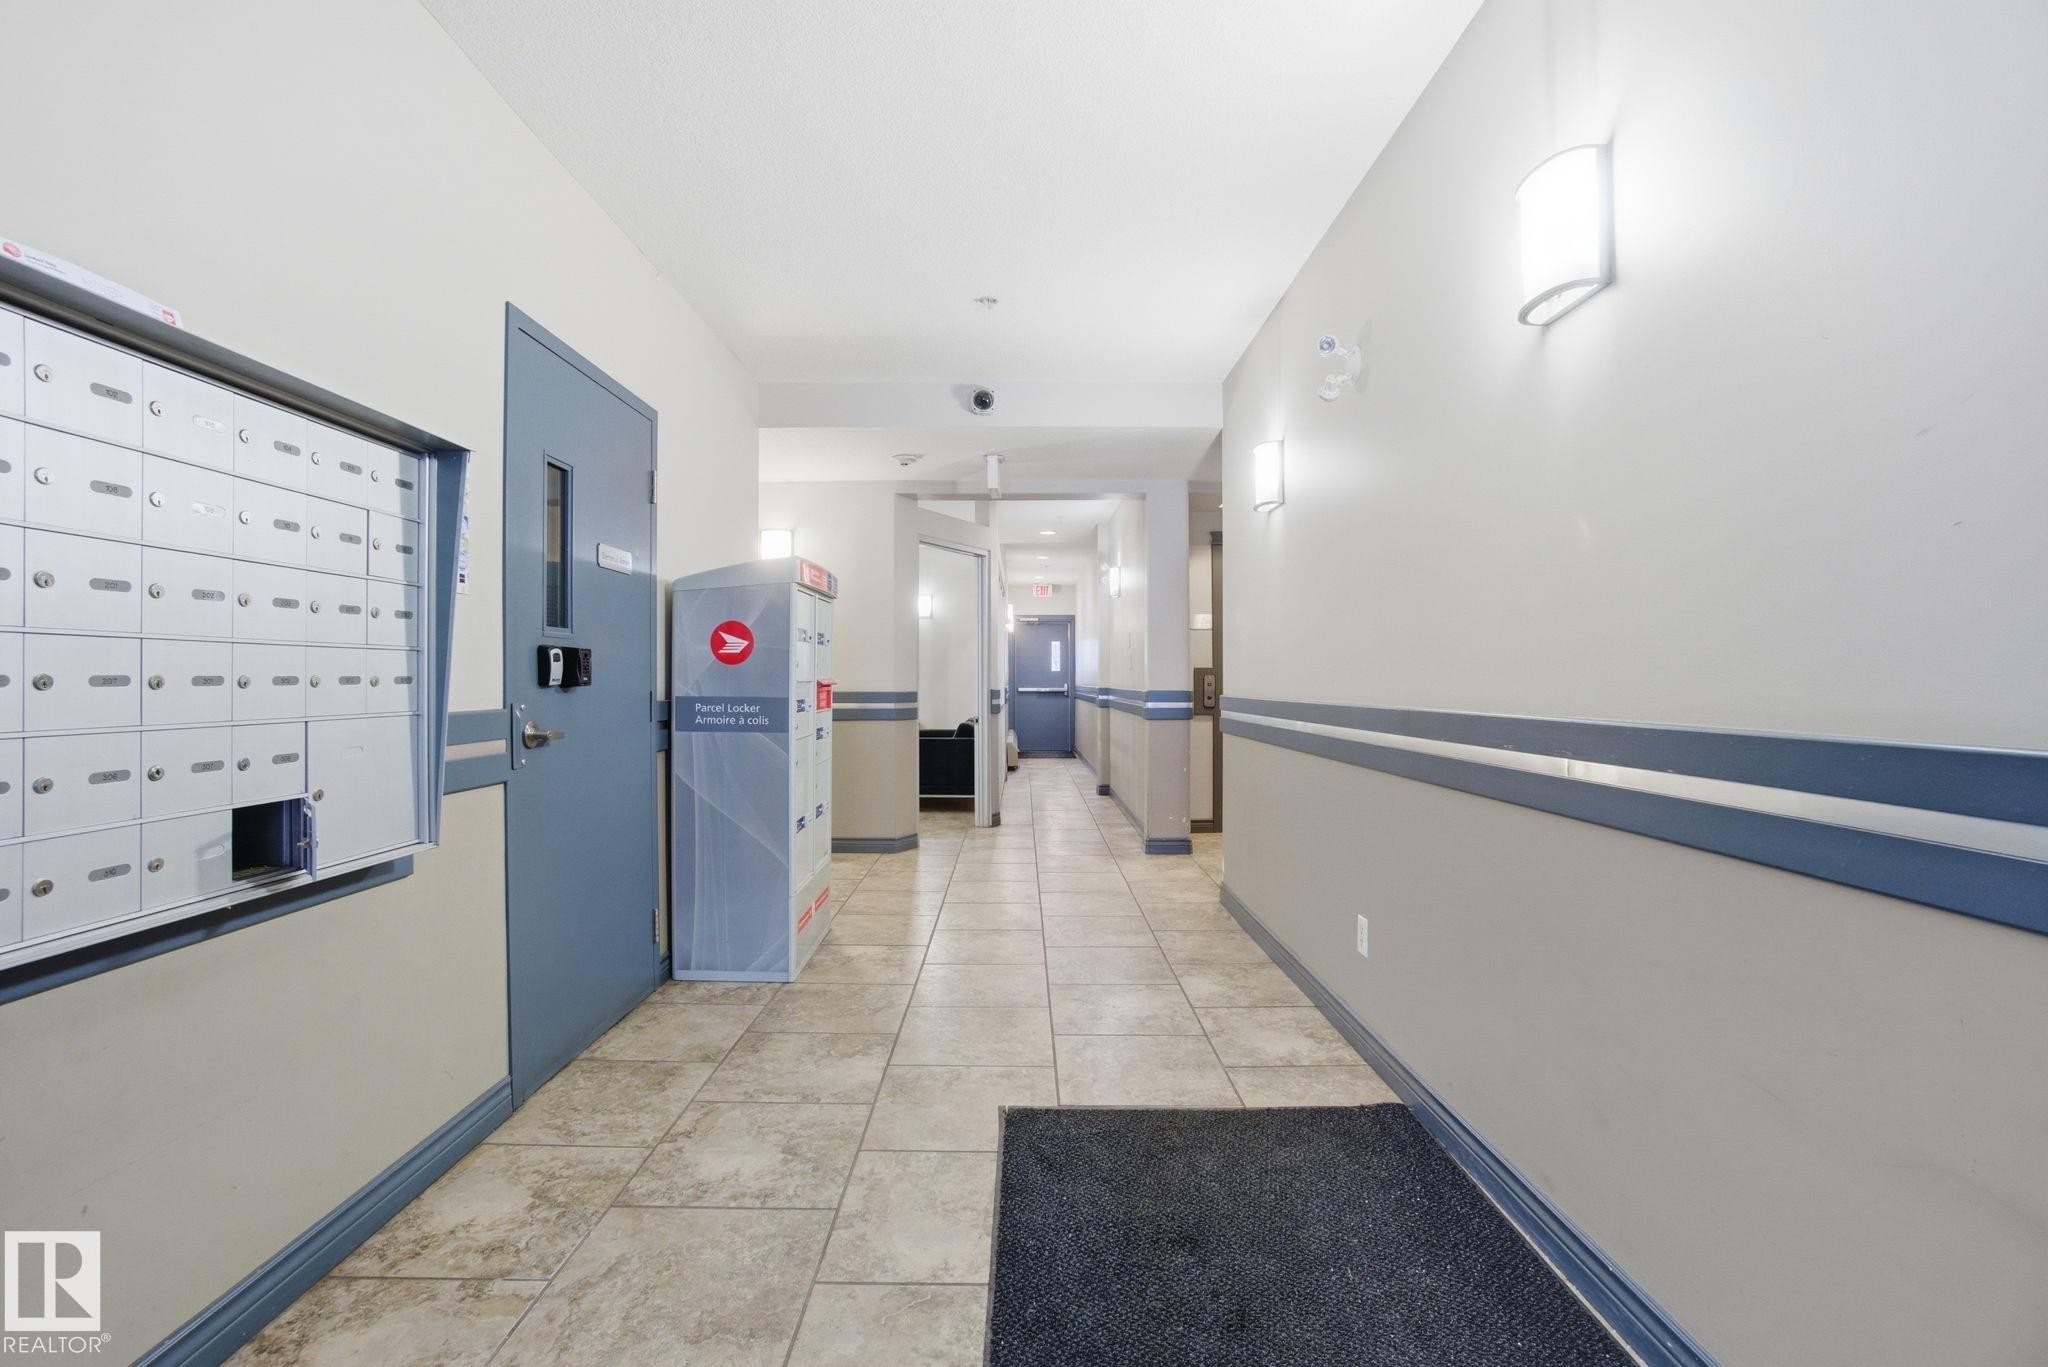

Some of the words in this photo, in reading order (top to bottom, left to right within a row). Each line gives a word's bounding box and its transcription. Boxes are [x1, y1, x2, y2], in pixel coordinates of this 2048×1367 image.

[105, 388, 119, 399] 102
[105, 485, 119, 495] 108
[104, 581, 118, 591] 201
[1035, 585, 1049, 596] EXIT
[201, 591, 215, 601] 202
[102, 677, 118, 685] 207
[695, 703, 725, 713] Parcel
[727, 703, 760, 713] Locker
[695, 715, 736, 725] Armoire
[739, 715, 745, 725] à
[747, 715, 769, 725] colis
